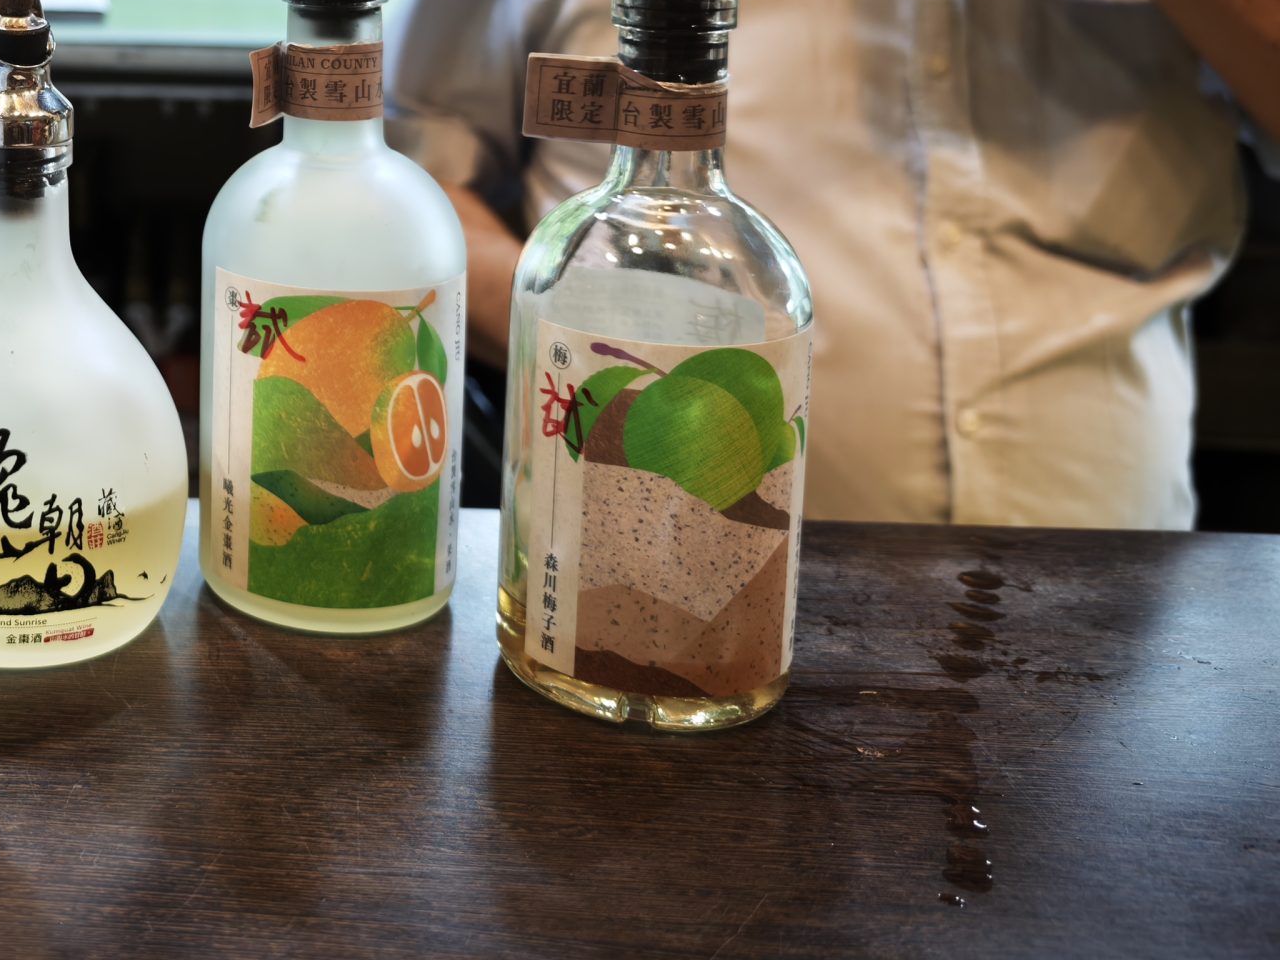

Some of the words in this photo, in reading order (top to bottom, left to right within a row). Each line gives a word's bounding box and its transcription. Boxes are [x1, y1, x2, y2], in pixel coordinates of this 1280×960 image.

[320, 56, 378, 70] COUNTY
[552, 71, 607, 97] 宜蘭
[550, 98, 603, 125] 限定
[551, 343, 569, 367] 梅
[539, 552, 560, 655] 森川梅子酒
[14, 617, 48, 627] Sunrise
